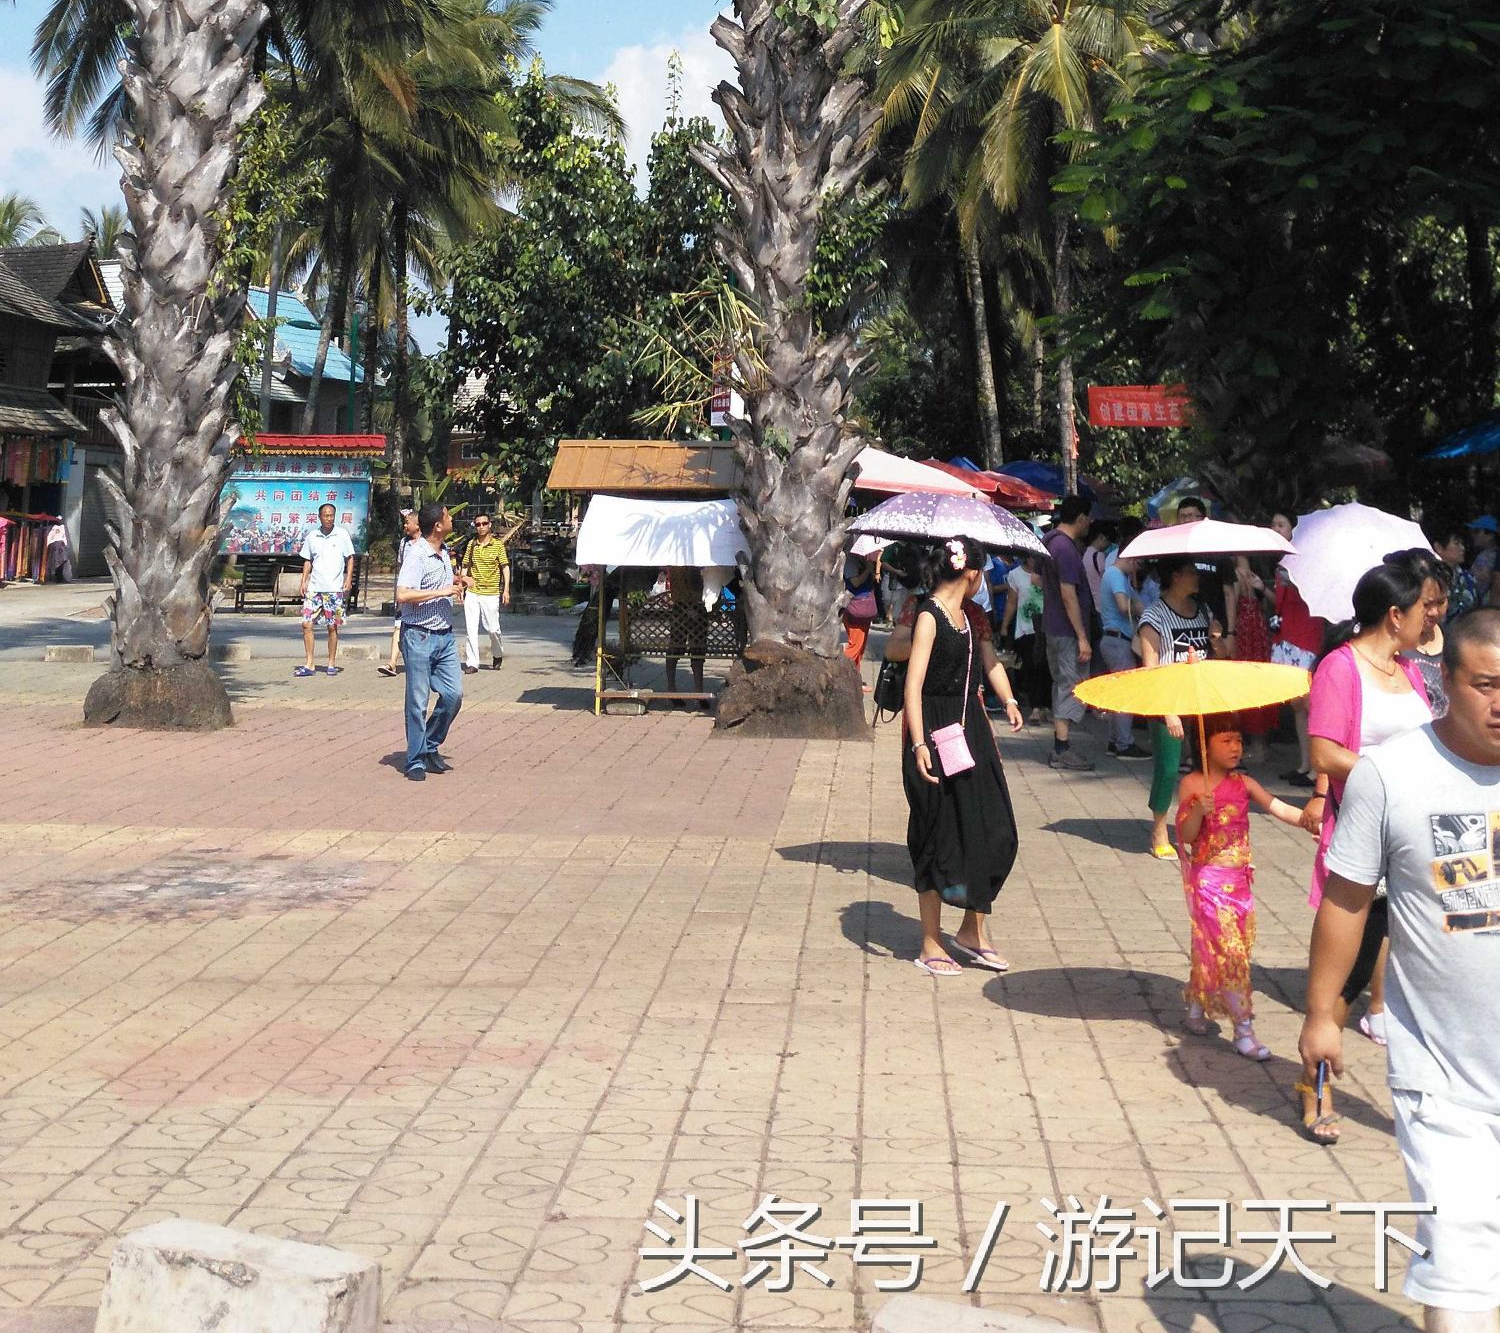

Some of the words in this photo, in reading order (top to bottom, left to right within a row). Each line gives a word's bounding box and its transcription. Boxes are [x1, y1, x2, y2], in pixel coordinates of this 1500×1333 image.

[255, 490, 355, 501] 共同团结奋斗
[253, 512, 353, 524] 共同繁荣展
[1440, 883, 1500, 912] STRENGT
